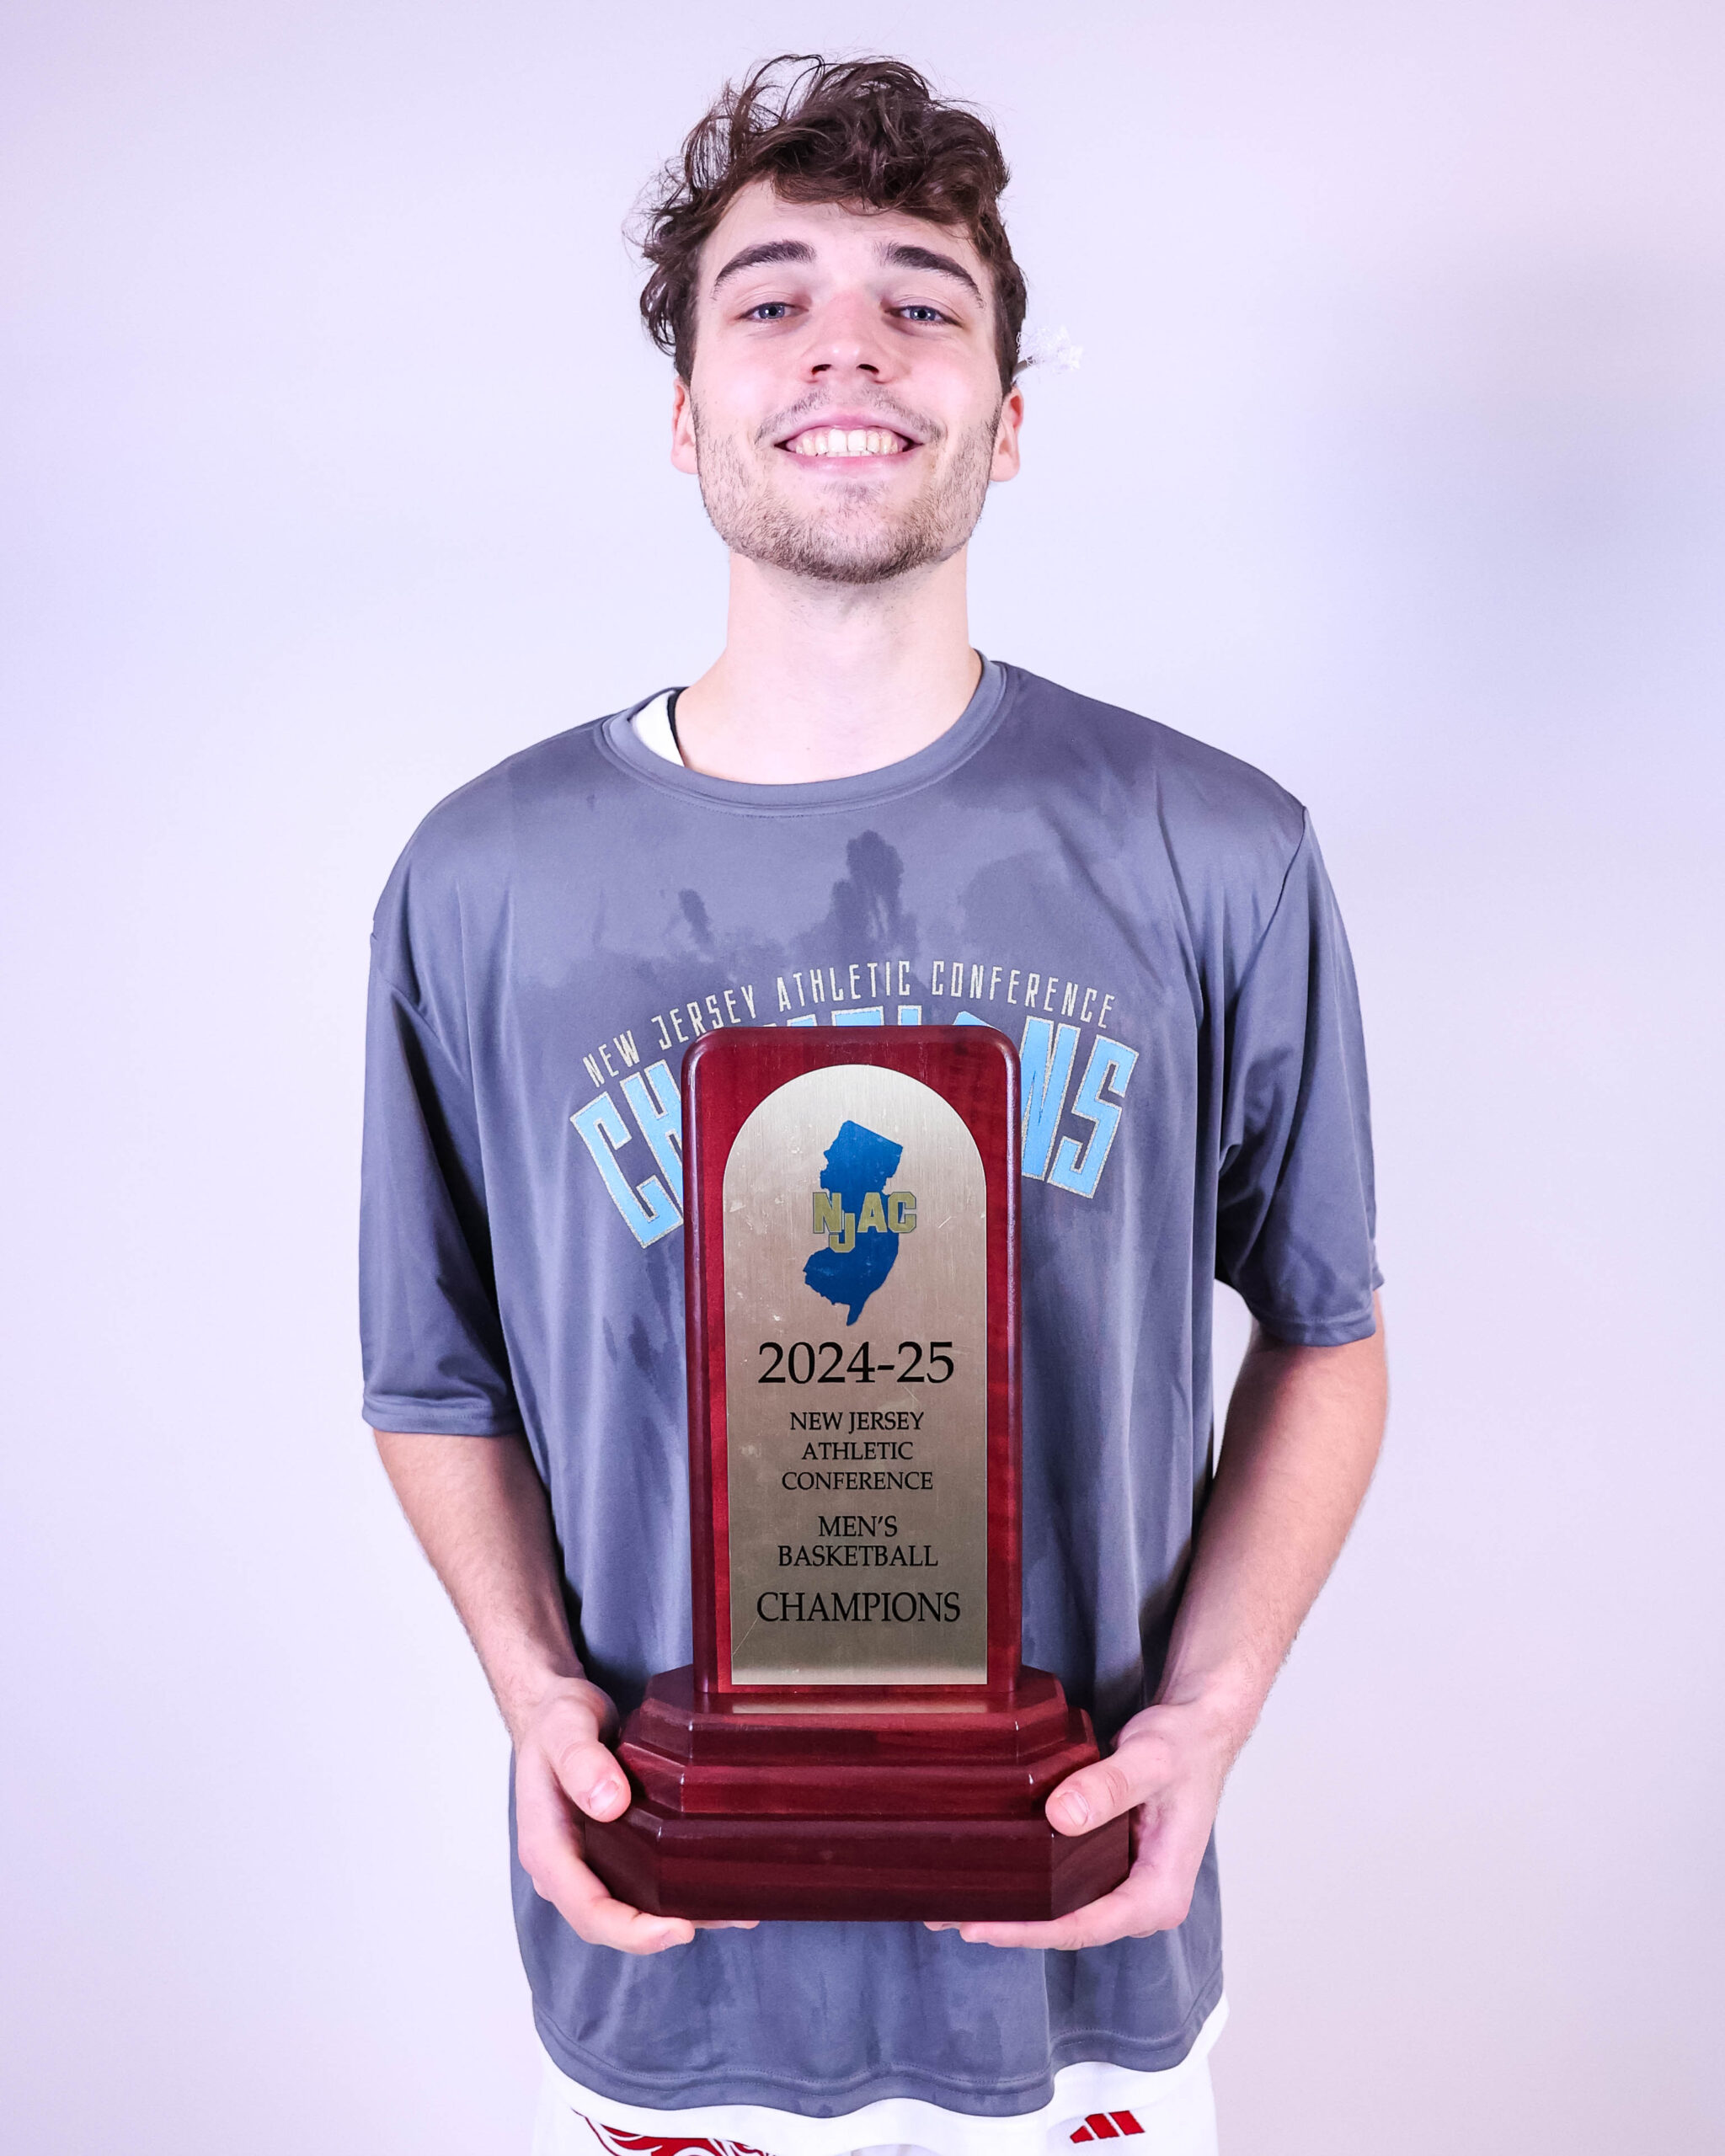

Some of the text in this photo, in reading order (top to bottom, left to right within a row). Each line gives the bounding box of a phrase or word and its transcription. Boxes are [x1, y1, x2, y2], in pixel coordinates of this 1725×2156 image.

[582, 960, 1115, 1088] NEW JERSEY ATHLETIC CONFERENCE
[812, 1191, 917, 1253] NJAC
[757, 1341, 955, 1385] 2024-25
[789, 1412, 926, 1434] NEW JERSEY
[801, 1442, 914, 1461] ATHLETIC
[781, 1471, 934, 1492] CONFERENCE
[817, 1516, 899, 1538] MEN'S
[777, 1545, 939, 1567] BASKETBALL
[756, 1592, 962, 1623] CHAMPIONS
